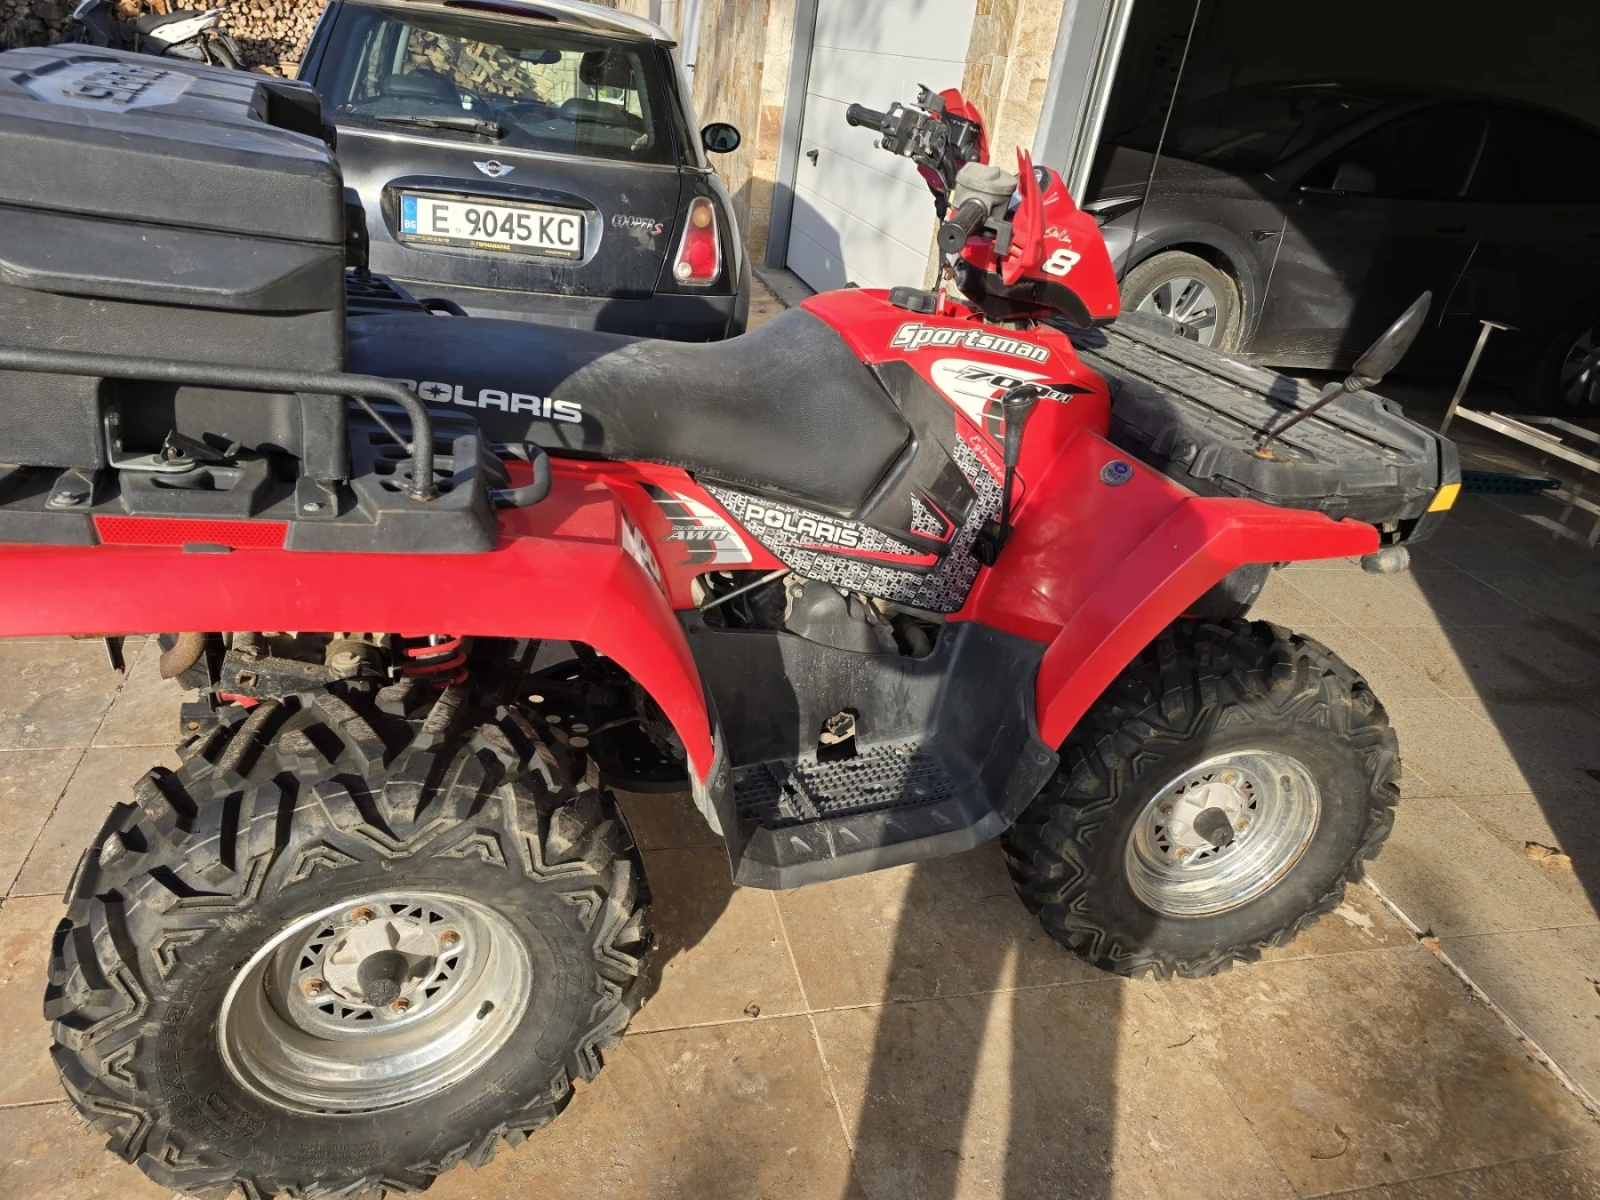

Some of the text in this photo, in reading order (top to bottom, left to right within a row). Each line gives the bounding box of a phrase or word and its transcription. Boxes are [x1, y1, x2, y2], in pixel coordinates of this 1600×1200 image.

[404, 220, 416, 229] BG
[431, 204, 574, 246] E 9045 KC
[650, 222, 664, 236] S
[1042, 249, 1081, 276] 8
[890, 321, 1050, 363] Sportsman
[664, 530, 730, 541] AWD
[744, 502, 861, 547] POLARIS
